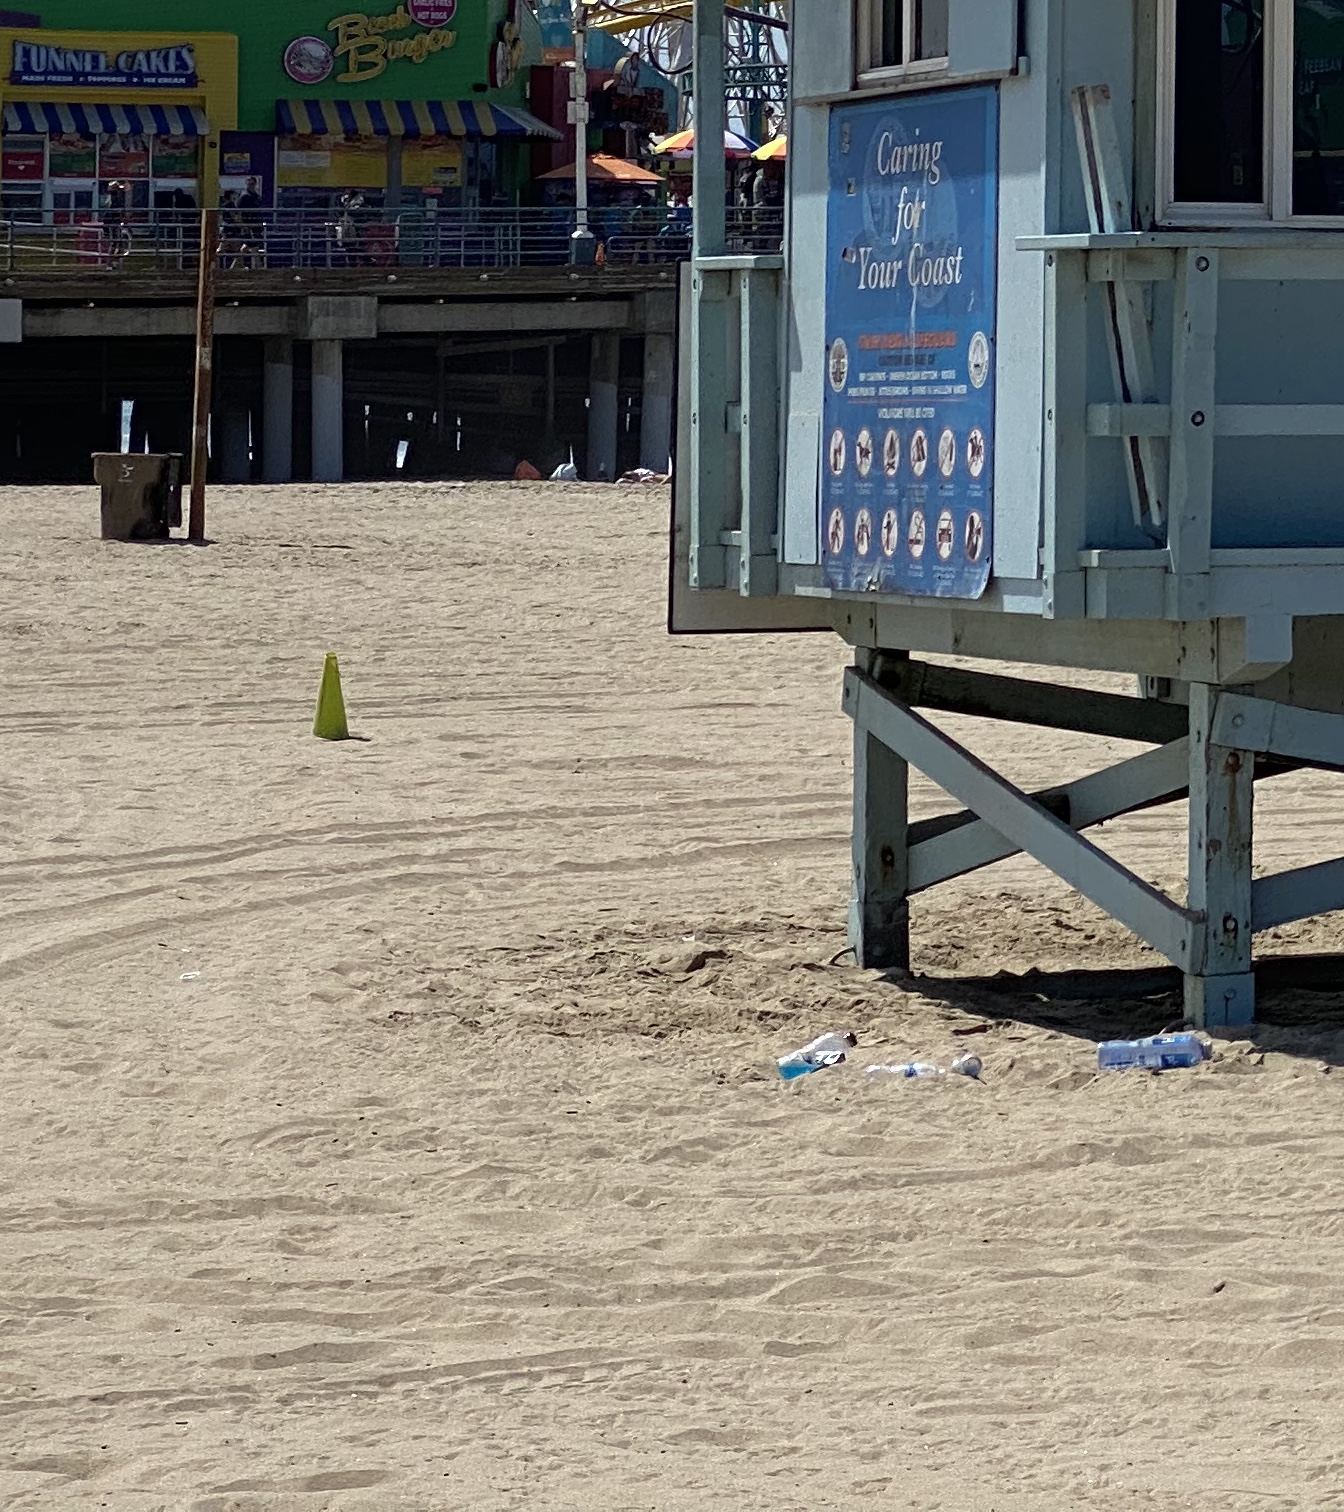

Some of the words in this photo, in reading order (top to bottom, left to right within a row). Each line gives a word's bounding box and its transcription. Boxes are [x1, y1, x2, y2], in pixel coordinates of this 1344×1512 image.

[328, 4, 412, 47] Beach
[13, 40, 112, 73] FUNNEL
[116, 44, 196, 75] CAKES
[333, 28, 457, 82] Burger
[877, 127, 944, 185] Caring
[891, 186, 926, 245] for
[857, 246, 903, 290] Your
[907, 242, 964, 287] Coast
